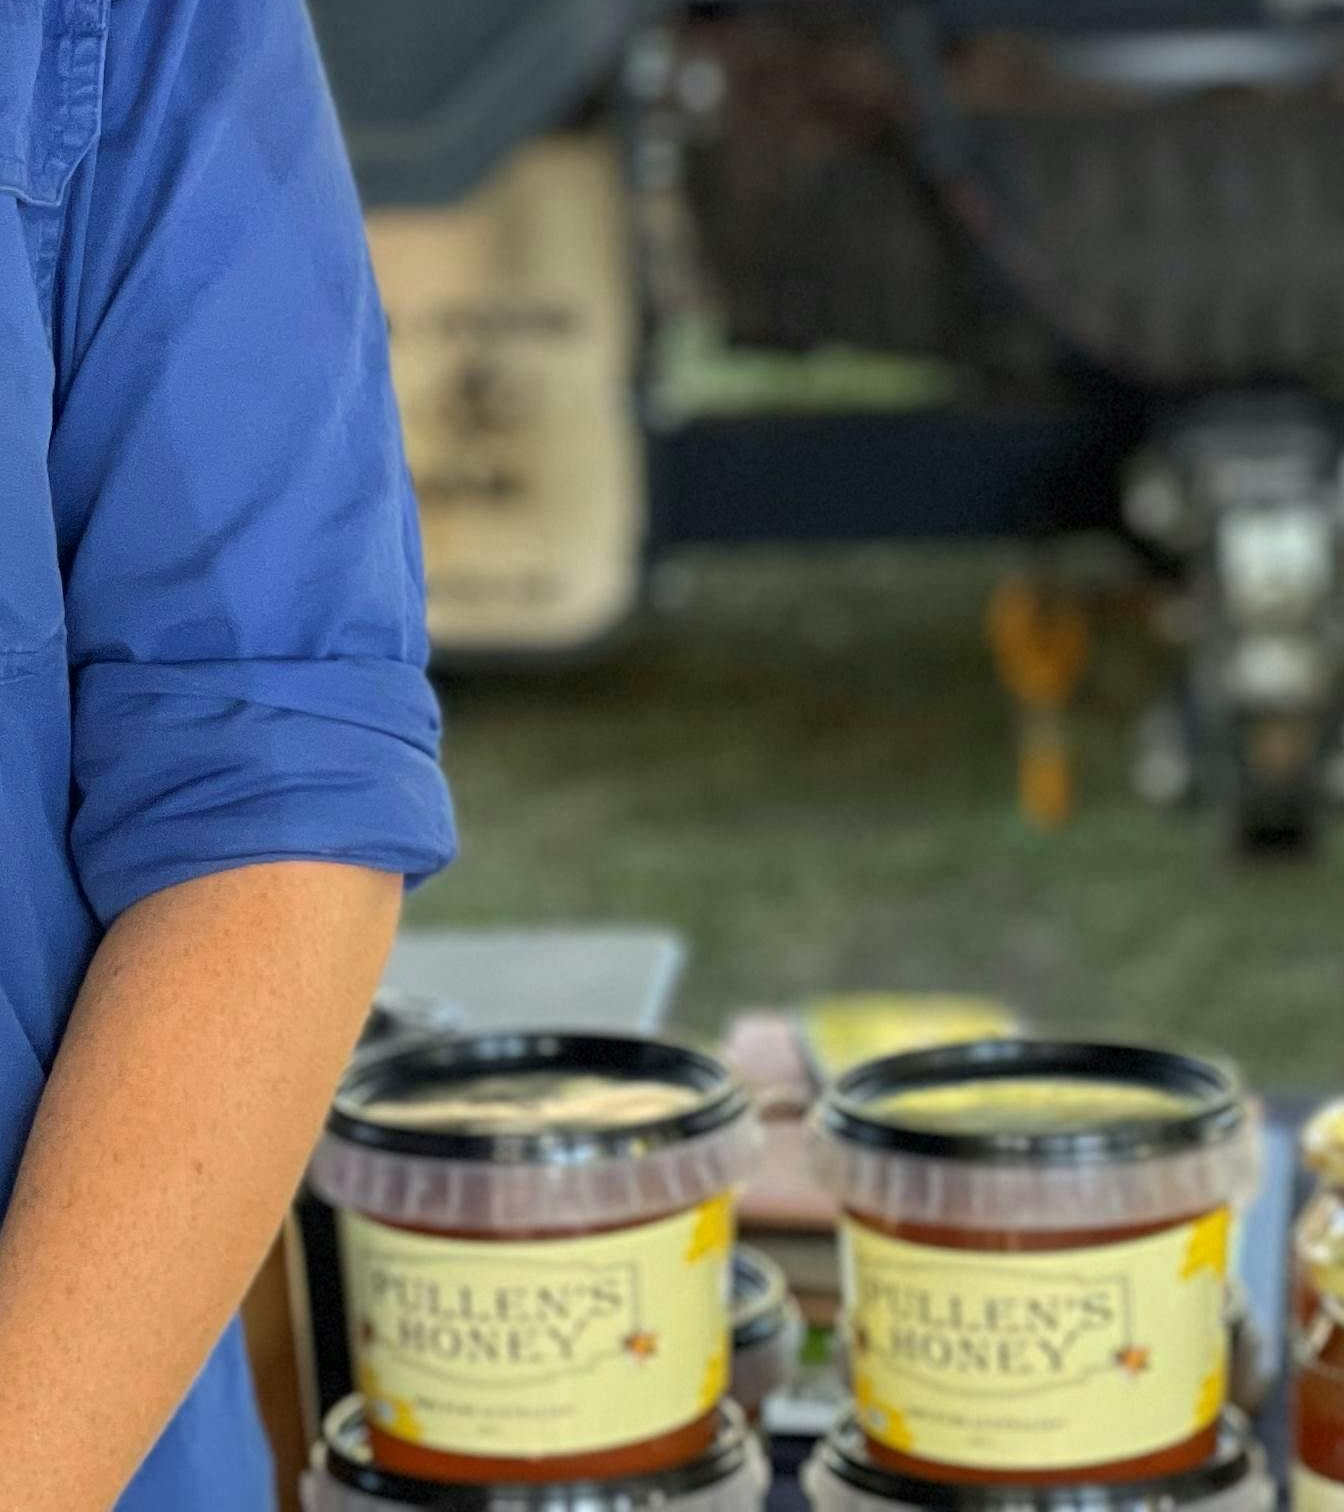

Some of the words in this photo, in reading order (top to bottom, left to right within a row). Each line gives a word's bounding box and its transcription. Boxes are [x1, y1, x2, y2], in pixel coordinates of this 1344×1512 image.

[369, 1268, 623, 1324] PULLEN'S
[394, 1314, 590, 1366] HONEY
[887, 1324, 1081, 1376] HONEY
